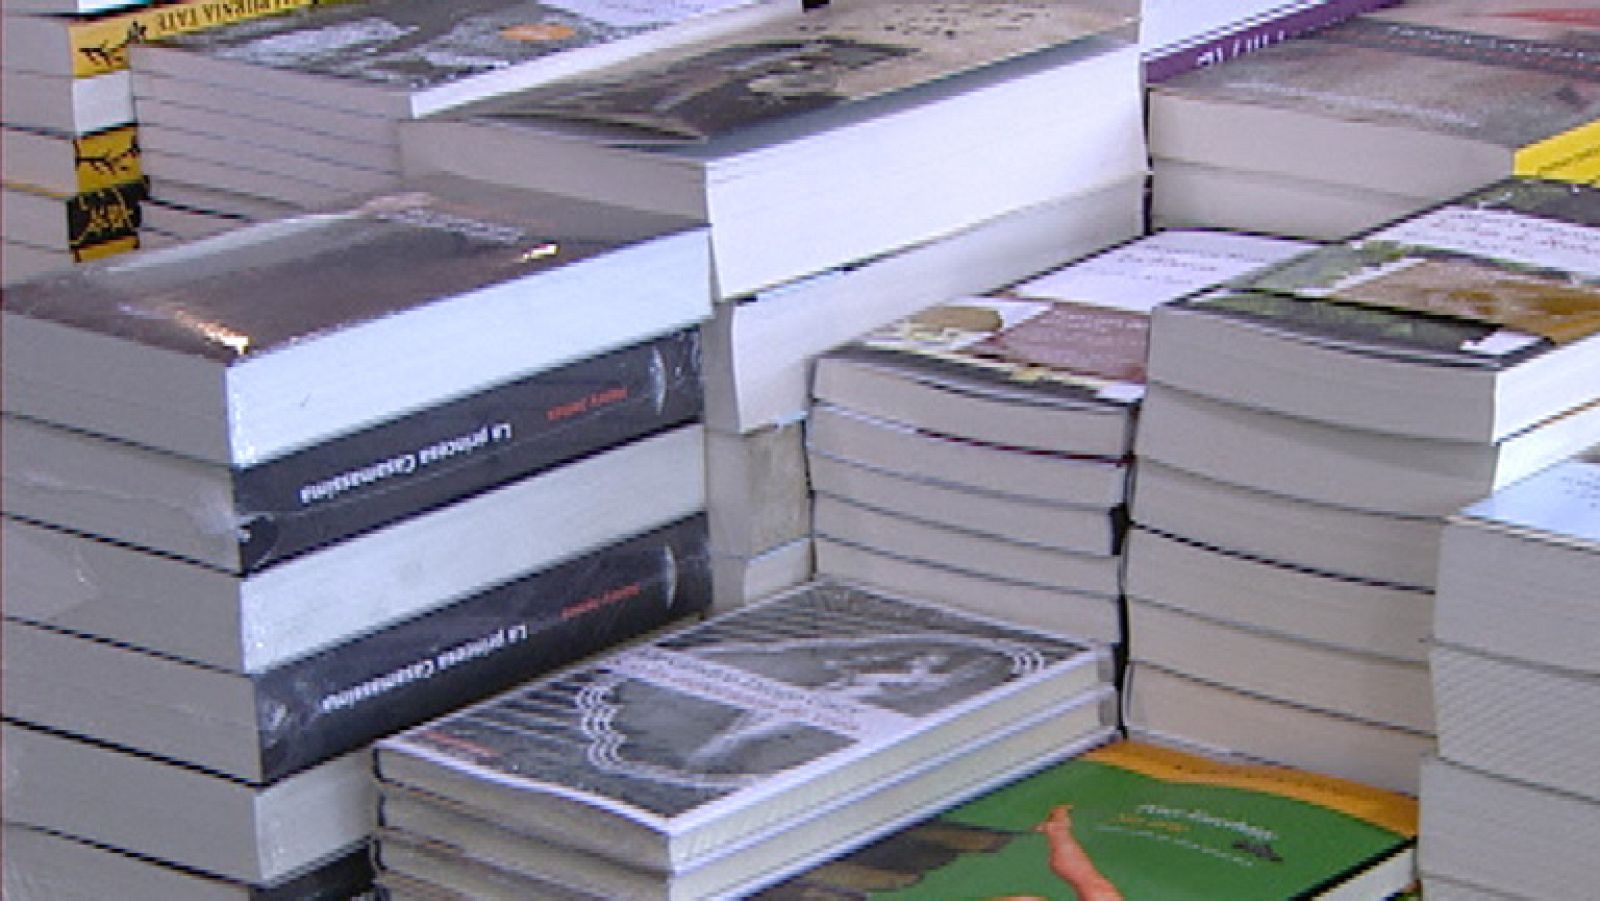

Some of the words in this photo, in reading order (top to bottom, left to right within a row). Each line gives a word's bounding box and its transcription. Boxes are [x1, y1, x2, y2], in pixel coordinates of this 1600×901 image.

[418, 425, 489, 465] princesa
[491, 422, 512, 441] La
[300, 454, 416, 504] Casamassima
[437, 628, 505, 671] princesa
[508, 624, 528, 644] La
[321, 659, 434, 713] Casamassima
